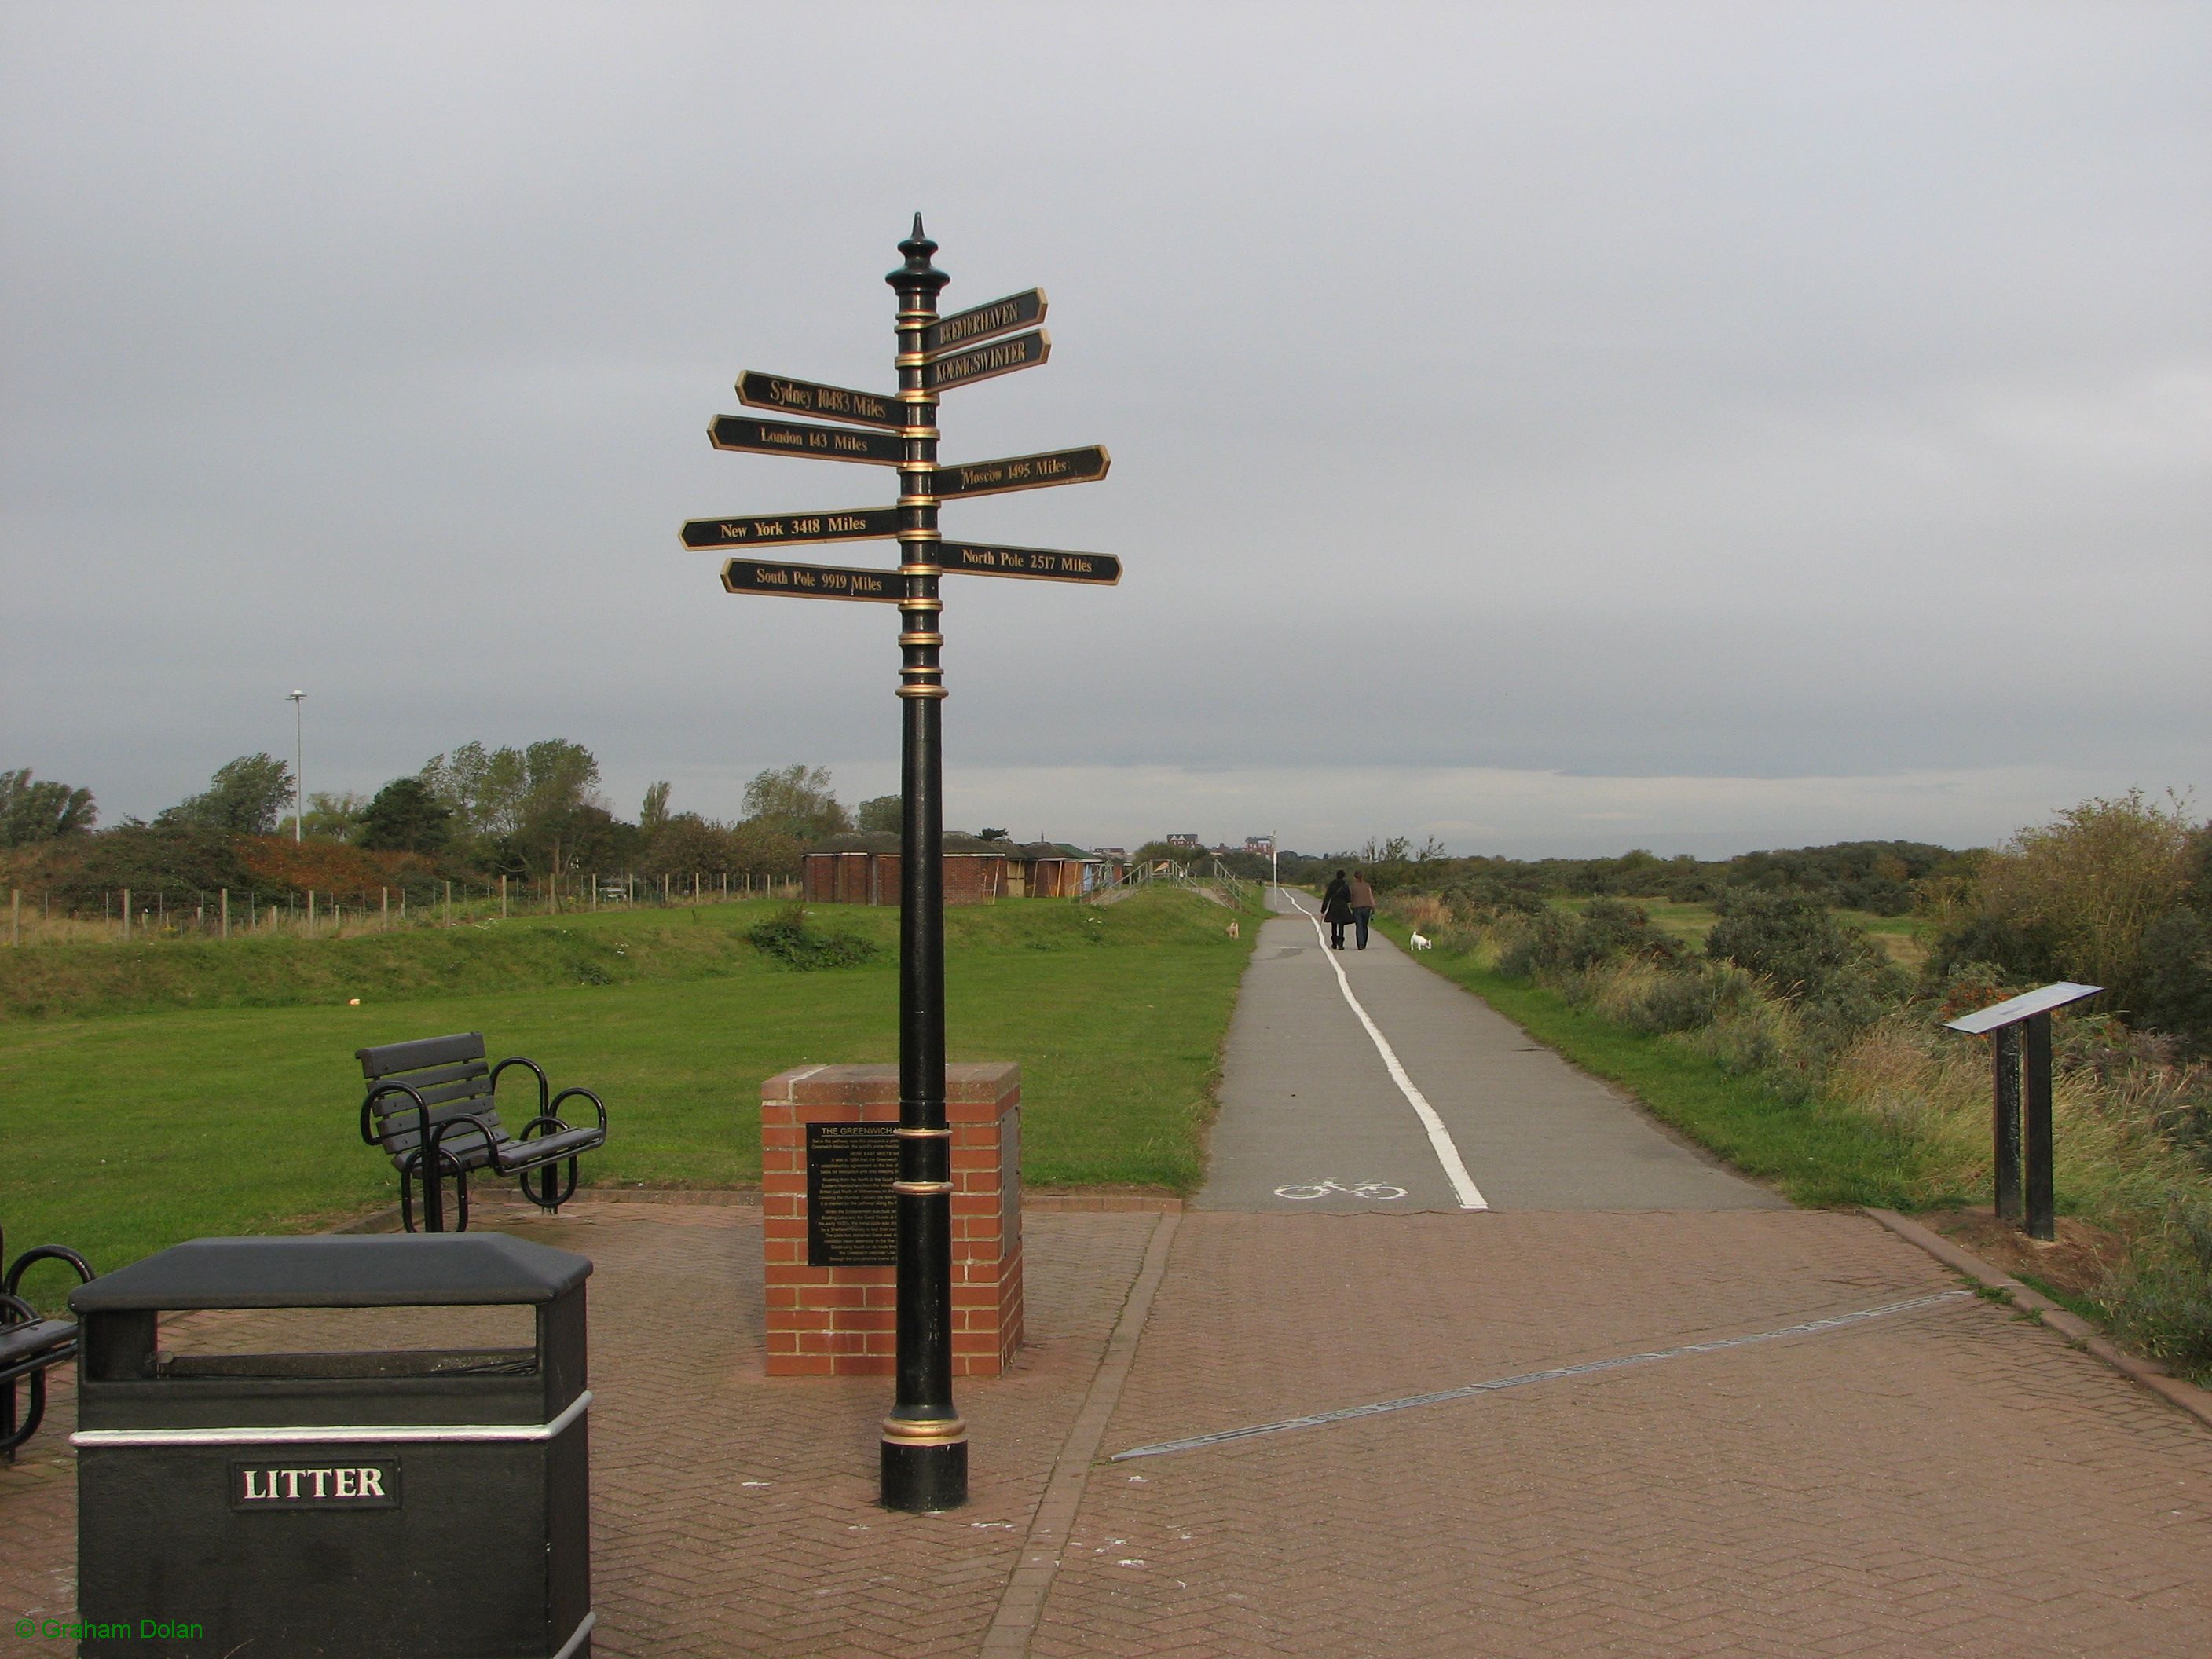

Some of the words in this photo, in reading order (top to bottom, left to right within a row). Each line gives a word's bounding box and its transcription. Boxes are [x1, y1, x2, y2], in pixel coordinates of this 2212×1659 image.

[939, 302, 1018, 344] BREMERHAVEN
[936, 342, 1026, 383] KOENIGSWINTER
[770, 379, 813, 410] Sydney
[817, 389, 850, 412] 10483
[853, 395, 886, 419] Miles
[760, 427, 803, 445] London
[809, 433, 827, 448] 143
[834, 434, 868, 452] Miles
[962, 469, 1003, 486] Moscow
[1008, 464, 1031, 479] 1495
[1036, 460, 1067, 476] Miles
[720, 524, 747, 539] New
[753, 522, 784, 537] York
[791, 518, 820, 534] 3418
[829, 517, 866, 532] Miles
[962, 549, 995, 565] North
[1000, 551, 1024, 567] Pole
[1031, 555, 1055, 569] 2517
[1061, 557, 1093, 573] Miles
[756, 568, 789, 585] South
[793, 570, 816, 588] Pole
[822, 573, 847, 588] 9919
[851, 576, 882, 591] Miles
[243, 1467, 386, 1500] LITTER
